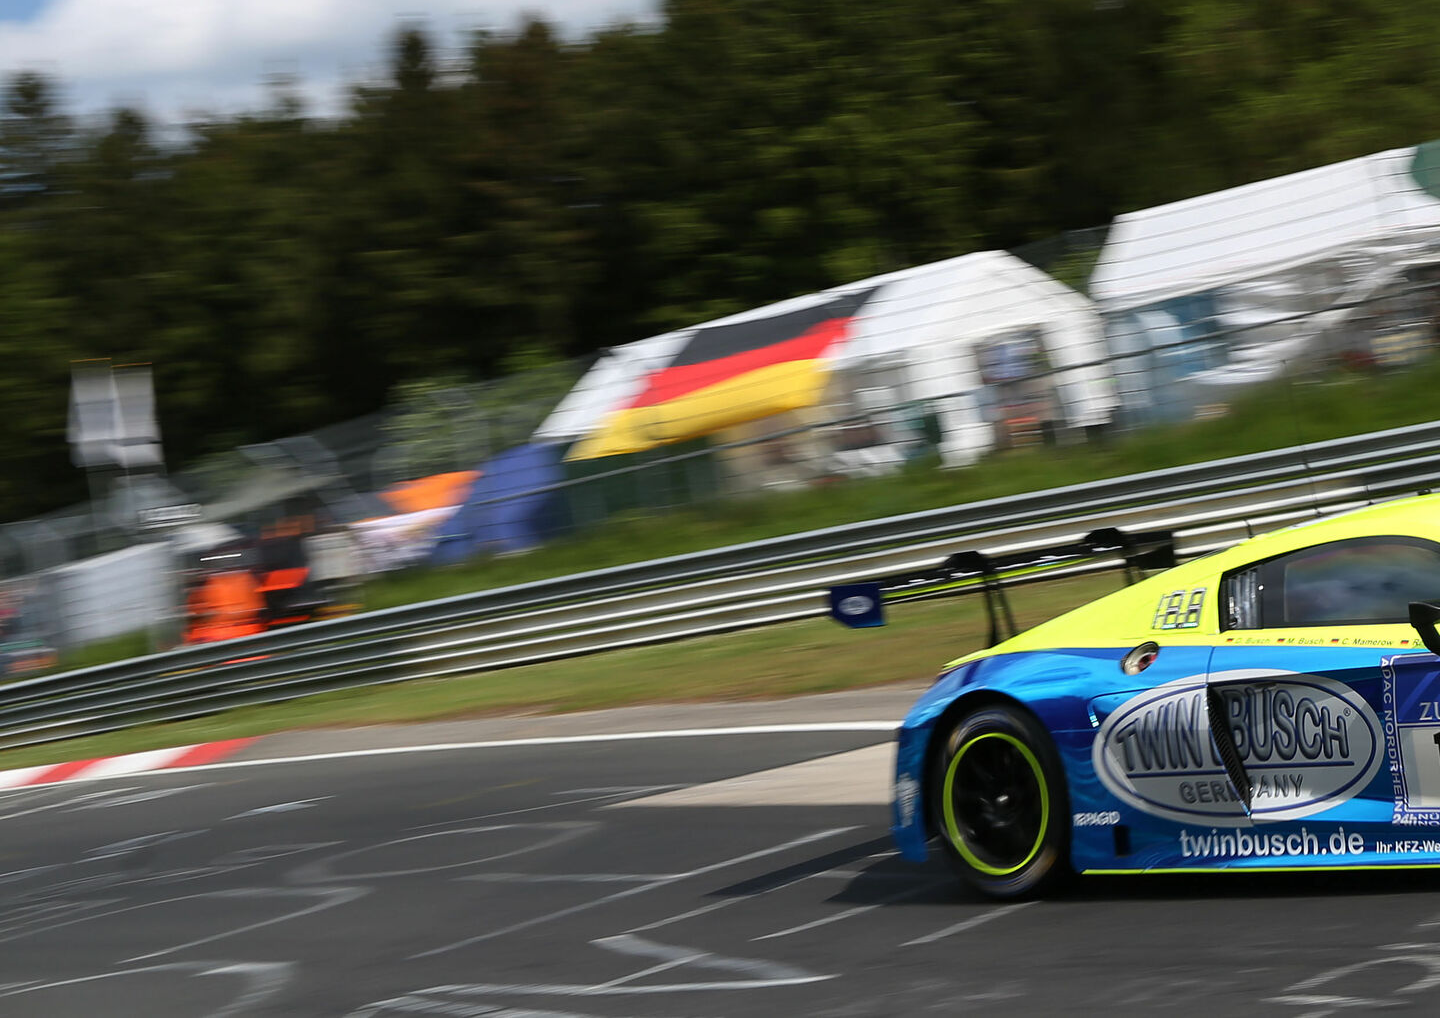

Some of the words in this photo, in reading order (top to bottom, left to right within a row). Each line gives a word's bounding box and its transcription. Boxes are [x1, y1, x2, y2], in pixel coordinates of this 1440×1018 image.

[1298, 637, 1325, 645] Busch
[1352, 638, 1393, 646] Mamerow
[1381, 657, 1392, 704] ADAC
[1115, 693, 1204, 772] TWIN
[1208, 687, 1350, 766] BUSCH
[1384, 710, 1404, 812] NORDRHEIN
[1180, 826, 1364, 857] twinbusch.de
[1376, 841, 1393, 854] Ihr
